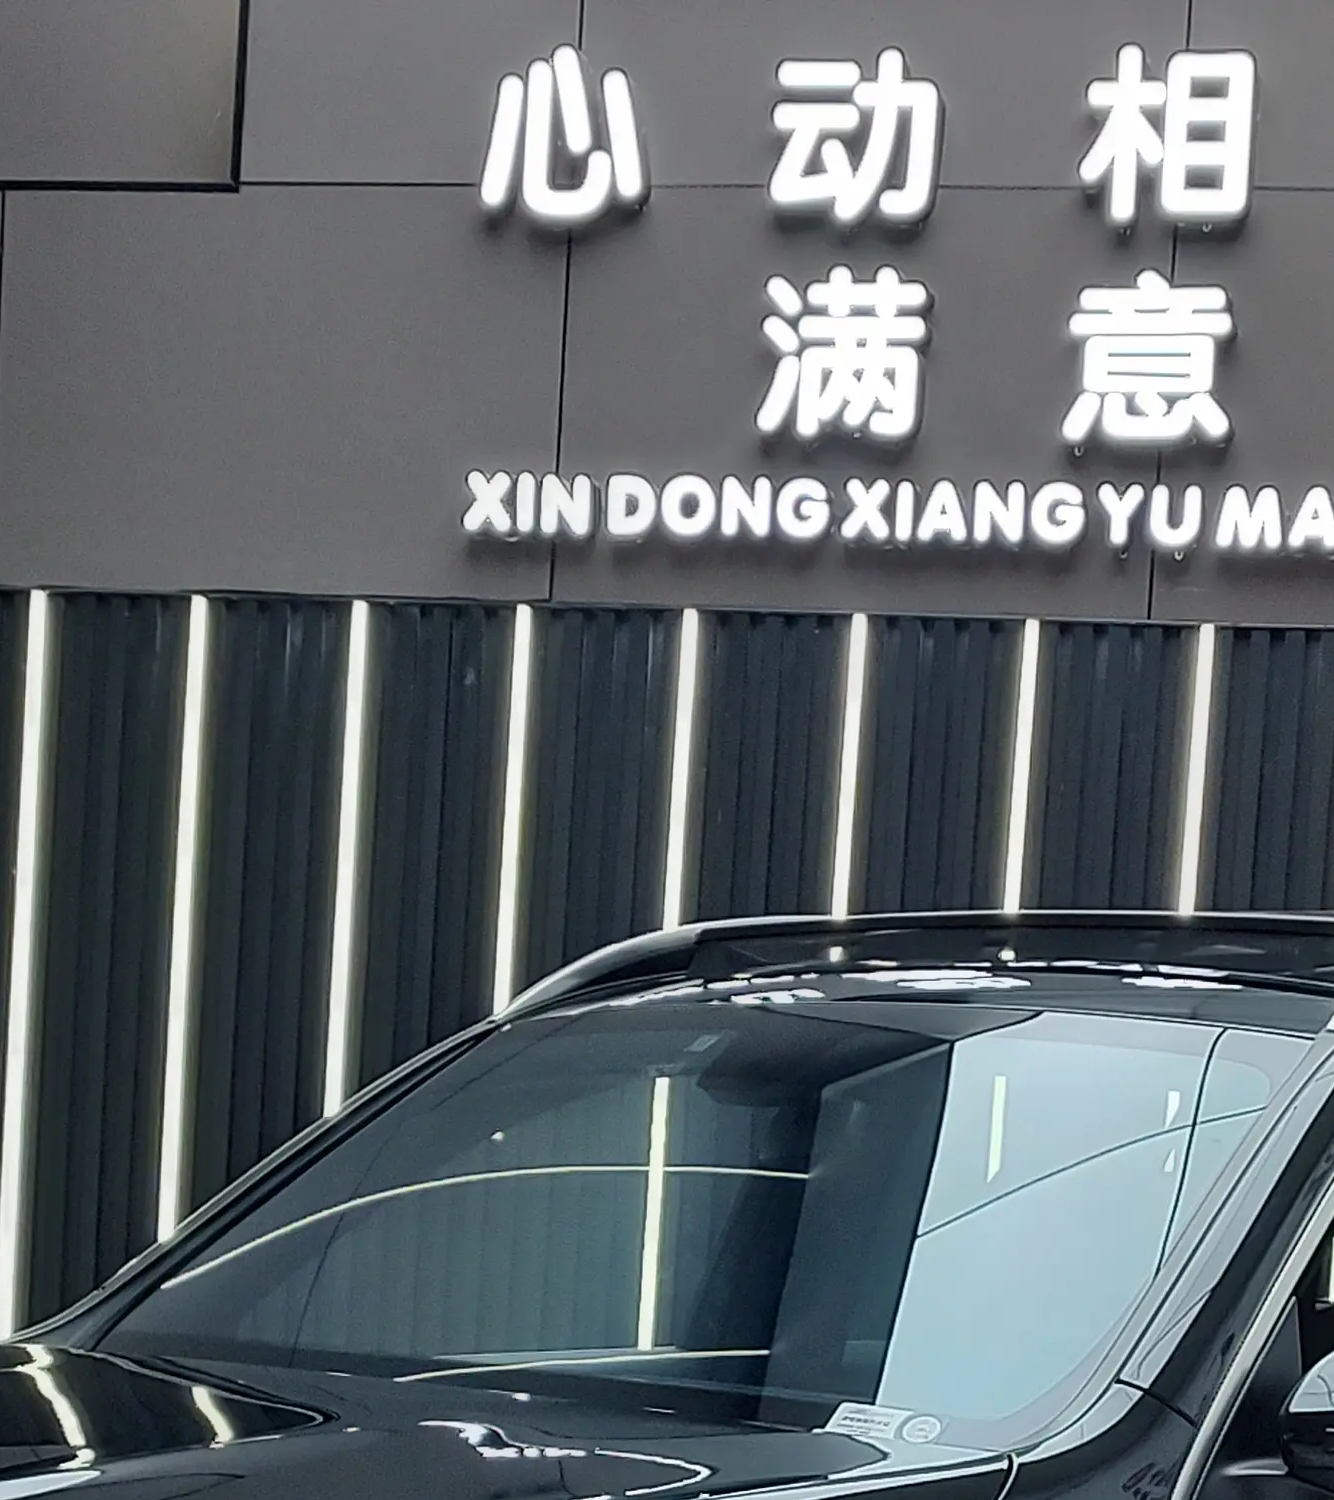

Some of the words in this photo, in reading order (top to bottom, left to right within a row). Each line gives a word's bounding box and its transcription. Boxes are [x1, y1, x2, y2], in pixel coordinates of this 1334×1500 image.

[462, 470, 592, 536] XIN
[606, 473, 831, 539] DONG
[840, 477, 1086, 545] XIANG
[1097, 482, 1203, 548] YU
